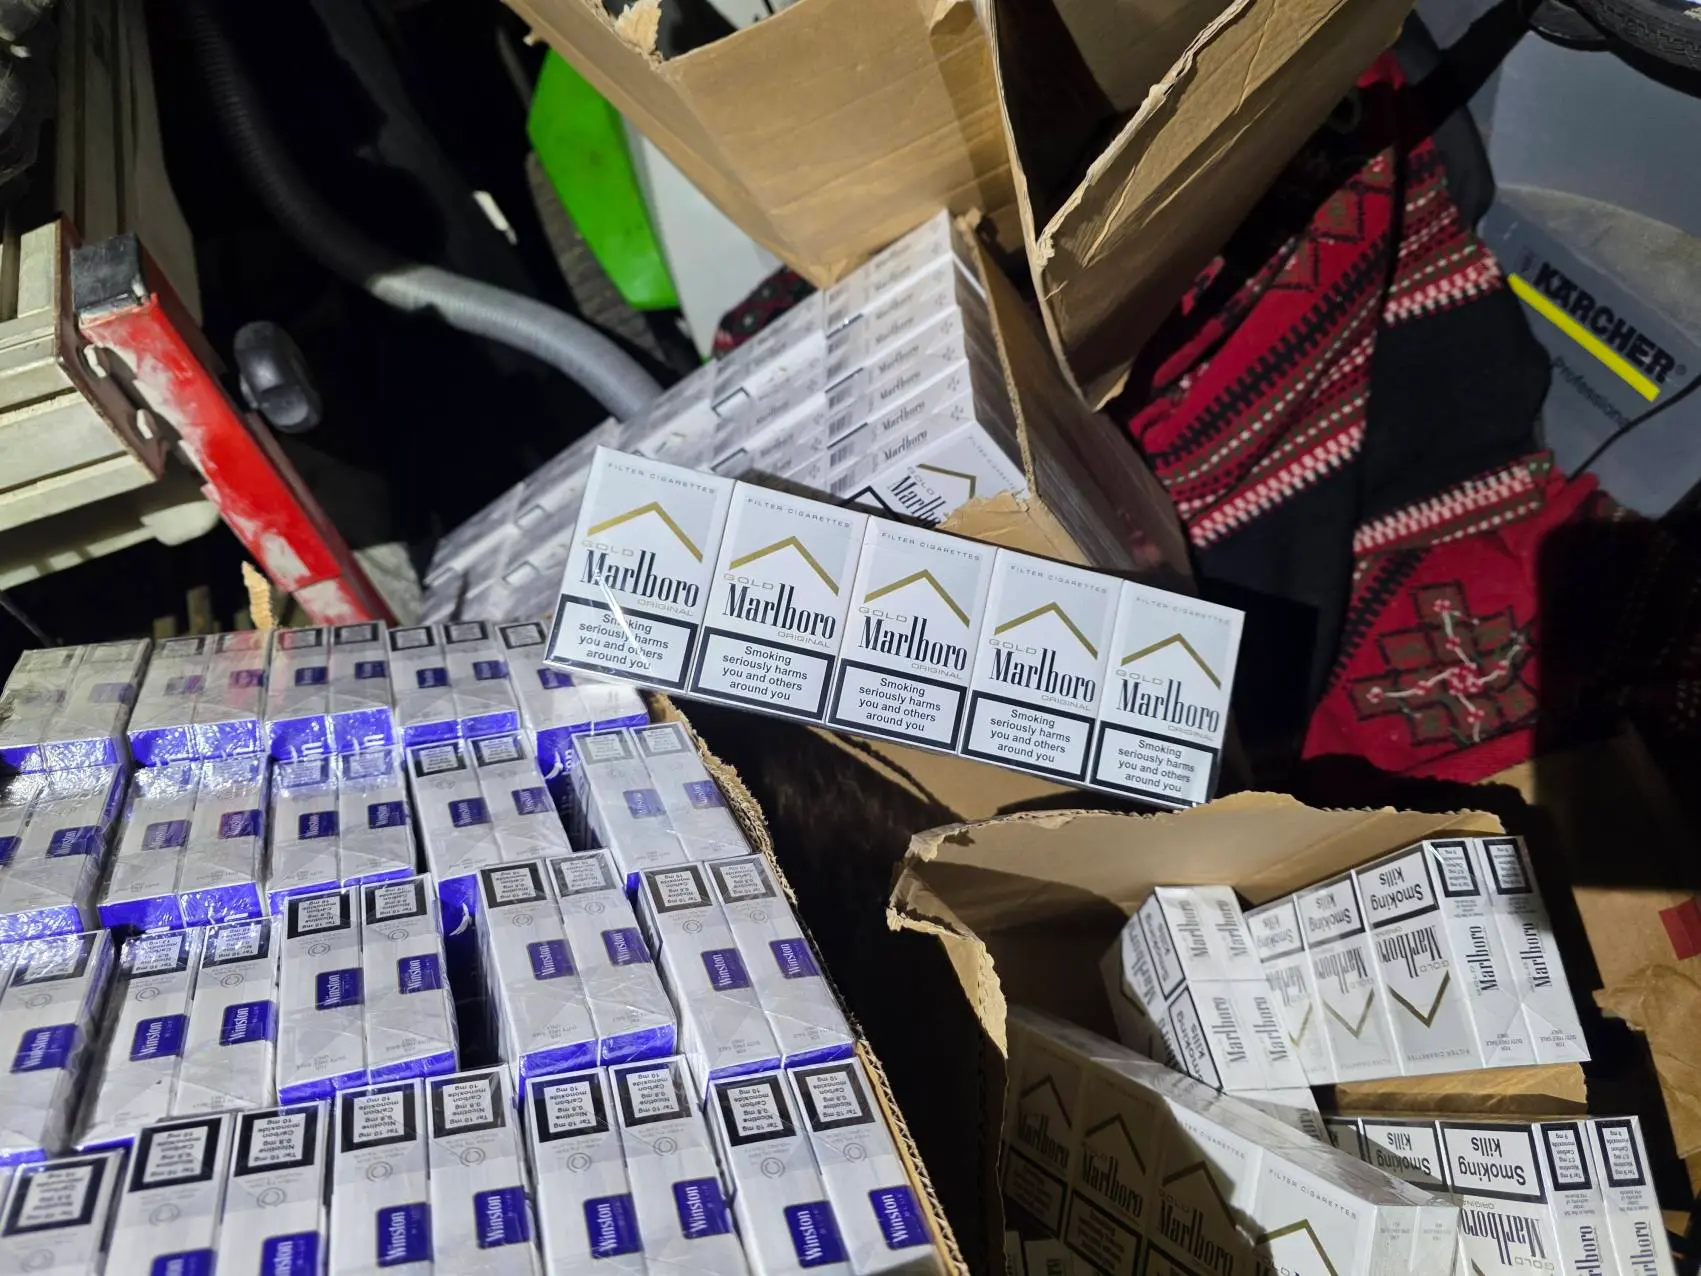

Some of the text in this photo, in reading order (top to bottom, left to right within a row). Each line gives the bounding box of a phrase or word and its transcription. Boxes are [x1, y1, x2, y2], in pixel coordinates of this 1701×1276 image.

[882, 402, 925, 431] Marlboro
[884, 430, 928, 461] Marlboro
[608, 463, 715, 494] FILTER CIGARETTES
[907, 466, 935, 495] GOLD
[748, 499, 850, 528] FILTER CIGARETTES
[582, 540, 634, 557] GOLD
[881, 533, 980, 561] FILTER CIGARETTES
[579, 549, 700, 607] Marlboro
[724, 574, 774, 590] GOLD
[1011, 565, 1107, 593] FILTER CIGARETTES
[637, 599, 694, 617] ORIGINAL
[722, 583, 836, 639] Marlboro
[859, 607, 907, 622] GOLD
[579, 623, 669, 648] seriously harms
[579, 635, 600, 644] you
[604, 641, 625, 652] and
[777, 632, 830, 648] ORIGINAL
[858, 616, 967, 671] Marlboro
[989, 639, 1037, 654] GOLD
[586, 649, 651, 669] around you
[723, 655, 807, 680] seriously harms
[745, 646, 792, 665] Smoking
[722, 667, 803, 690] you and others
[911, 663, 962, 680] ORIGINAL
[989, 648, 1096, 702] Marlboro
[1116, 669, 1163, 685] GOLD
[730, 681, 790, 700] around you
[859, 687, 941, 711] seriously harms
[880, 678, 925, 696] Smoking
[859, 699, 935, 721] you and others
[1042, 695, 1091, 711] ORIGINAL
[1116, 679, 1220, 732] Marlboro
[866, 712, 925, 731] around you
[990, 718, 1071, 742] seriously harms
[1011, 710, 1055, 728] Smoking
[990, 730, 1066, 753] you and others
[998, 743, 1055, 762] around you
[1138, 740, 1182, 759] Smoking
[1118, 748, 1195, 772] seriously harms
[1118, 760, 1190, 783] you and others
[1125, 773, 1181, 792] around you
[1379, 868, 1405, 887] kills
[1371, 884, 1423, 911] Smoking
[1177, 901, 1208, 957] Marlboro
[1215, 900, 1248, 956] Marlboro
[1309, 909, 1352, 931] Smoking
[540, 945, 556, 975] Winston
[614, 933, 630, 962] Winston
[781, 944, 800, 974] Winston
[1376, 925, 1443, 979] Marlboro
[1466, 925, 1500, 991] Marlboro
[1519, 923, 1552, 988] Marlboro
[407, 960, 422, 990] Winston
[713, 954, 732, 986] Winston
[1315, 946, 1368, 994] Marlboro
[1420, 961, 1449, 972] GOLD
[324, 975, 340, 1005] Winston
[229, 1008, 249, 1040] Winston
[1212, 997, 1246, 1062] Marlboro
[1253, 997, 1288, 1062] Marlboro
[23, 1031, 50, 1067] Winston
[139, 1022, 162, 1055] Winston
[1190, 1022, 1205, 1058] kills
[550, 1091, 587, 1100] monoxide
[734, 1094, 769, 1102] monoxide
[743, 1115, 773, 1123] Nicotine
[1018, 1111, 1070, 1169] Marlboro
[1387, 1132, 1412, 1150] kills
[1472, 1137, 1503, 1158] kills
[1377, 1150, 1431, 1176] Smoking
[1458, 1156, 1526, 1185] Smoking
[1083, 1148, 1144, 1217] Marlboro
[1270, 1169, 1357, 1220] FILTER CIGARETTES
[485, 1196, 504, 1242] Winston
[685, 1186, 708, 1232] Winston
[882, 1194, 909, 1242] Winston
[386, 1212, 406, 1260] Winston
[597, 1204, 619, 1251] Winston
[797, 1211, 823, 1260] Winston
[1160, 1199, 1234, 1276] Marlboro
[1462, 1209, 1546, 1265] Marlboro
[1515, 1256, 1554, 1270] GOLD
